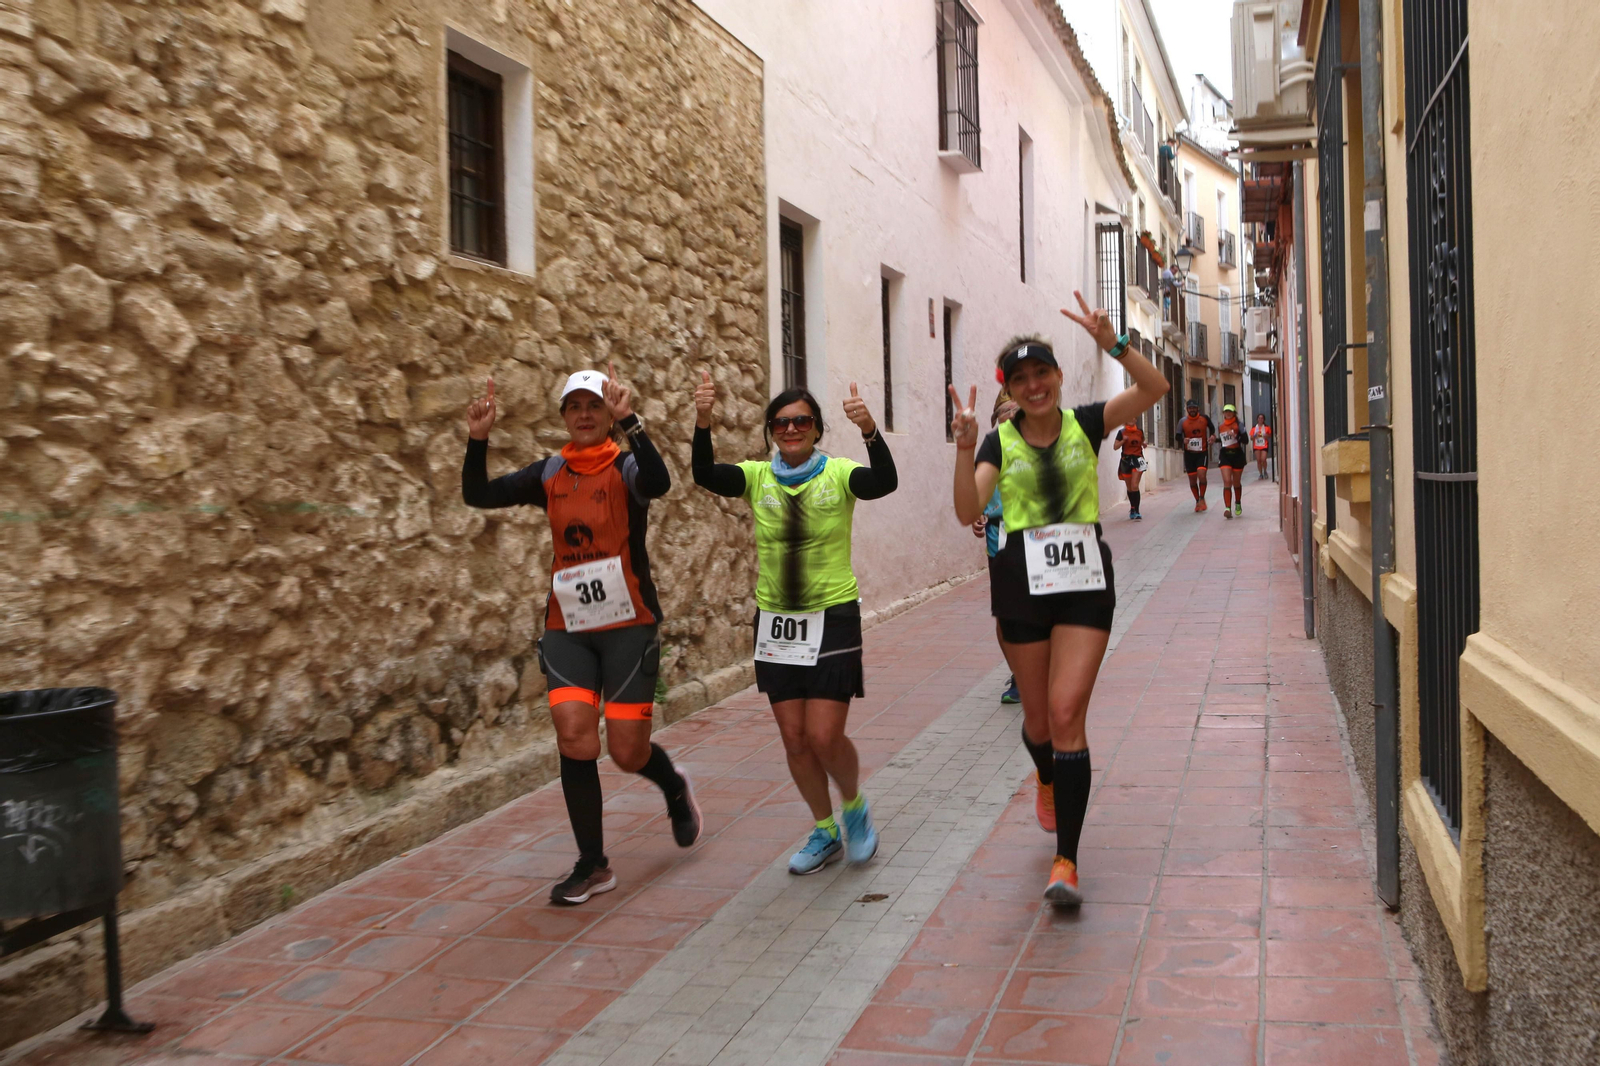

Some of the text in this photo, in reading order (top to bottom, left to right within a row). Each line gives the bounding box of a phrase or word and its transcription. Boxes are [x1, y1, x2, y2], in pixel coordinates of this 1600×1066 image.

[1044, 541, 1086, 567] 941
[575, 579, 607, 605] 38
[771, 615, 808, 642] 601
